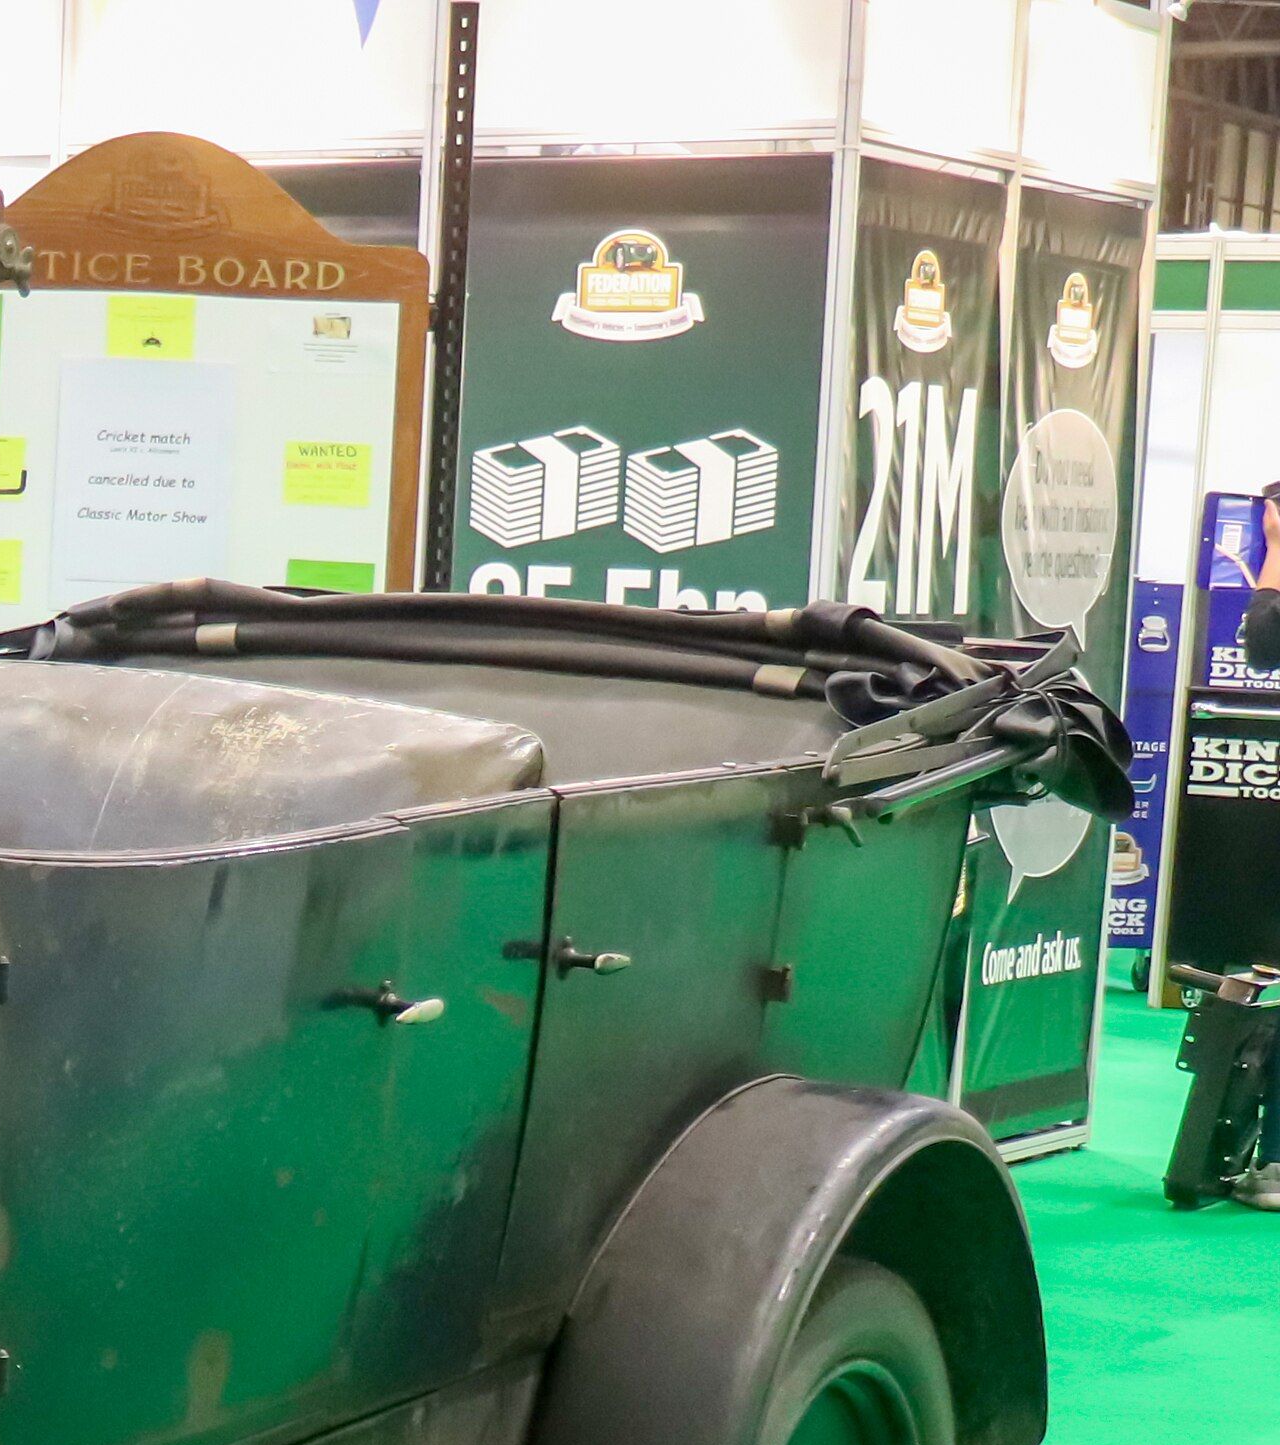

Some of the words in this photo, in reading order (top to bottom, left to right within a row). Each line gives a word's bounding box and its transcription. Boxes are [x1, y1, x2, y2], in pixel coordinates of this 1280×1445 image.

[37, 249, 151, 285] TICE
[177, 255, 348, 292] BOARD
[587, 272, 673, 294] FEDERATION
[96, 429, 146, 444] Cricket
[149, 432, 191, 445] match
[295, 445, 357, 458] WANTED
[88, 474, 149, 487] cancelled
[153, 475, 177, 488] due
[182, 476, 195, 489] to
[846, 374, 978, 619] 21M
[76, 506, 121, 521] Classic
[126, 509, 168, 523] Motor
[171, 511, 208, 524] Show
[1212, 647, 1246, 662] KI
[1132, 740, 1167, 752] TAGE
[1192, 737, 1280, 762] KIN
[1189, 761, 1280, 787] DIC
[1110, 898, 1147, 912] NG
[1108, 913, 1146, 927] CK
[982, 941, 1016, 986] Come
[1015, 933, 1043, 979] and
[1042, 930, 1064, 974] ask
[1065, 936, 1082, 971] us.
